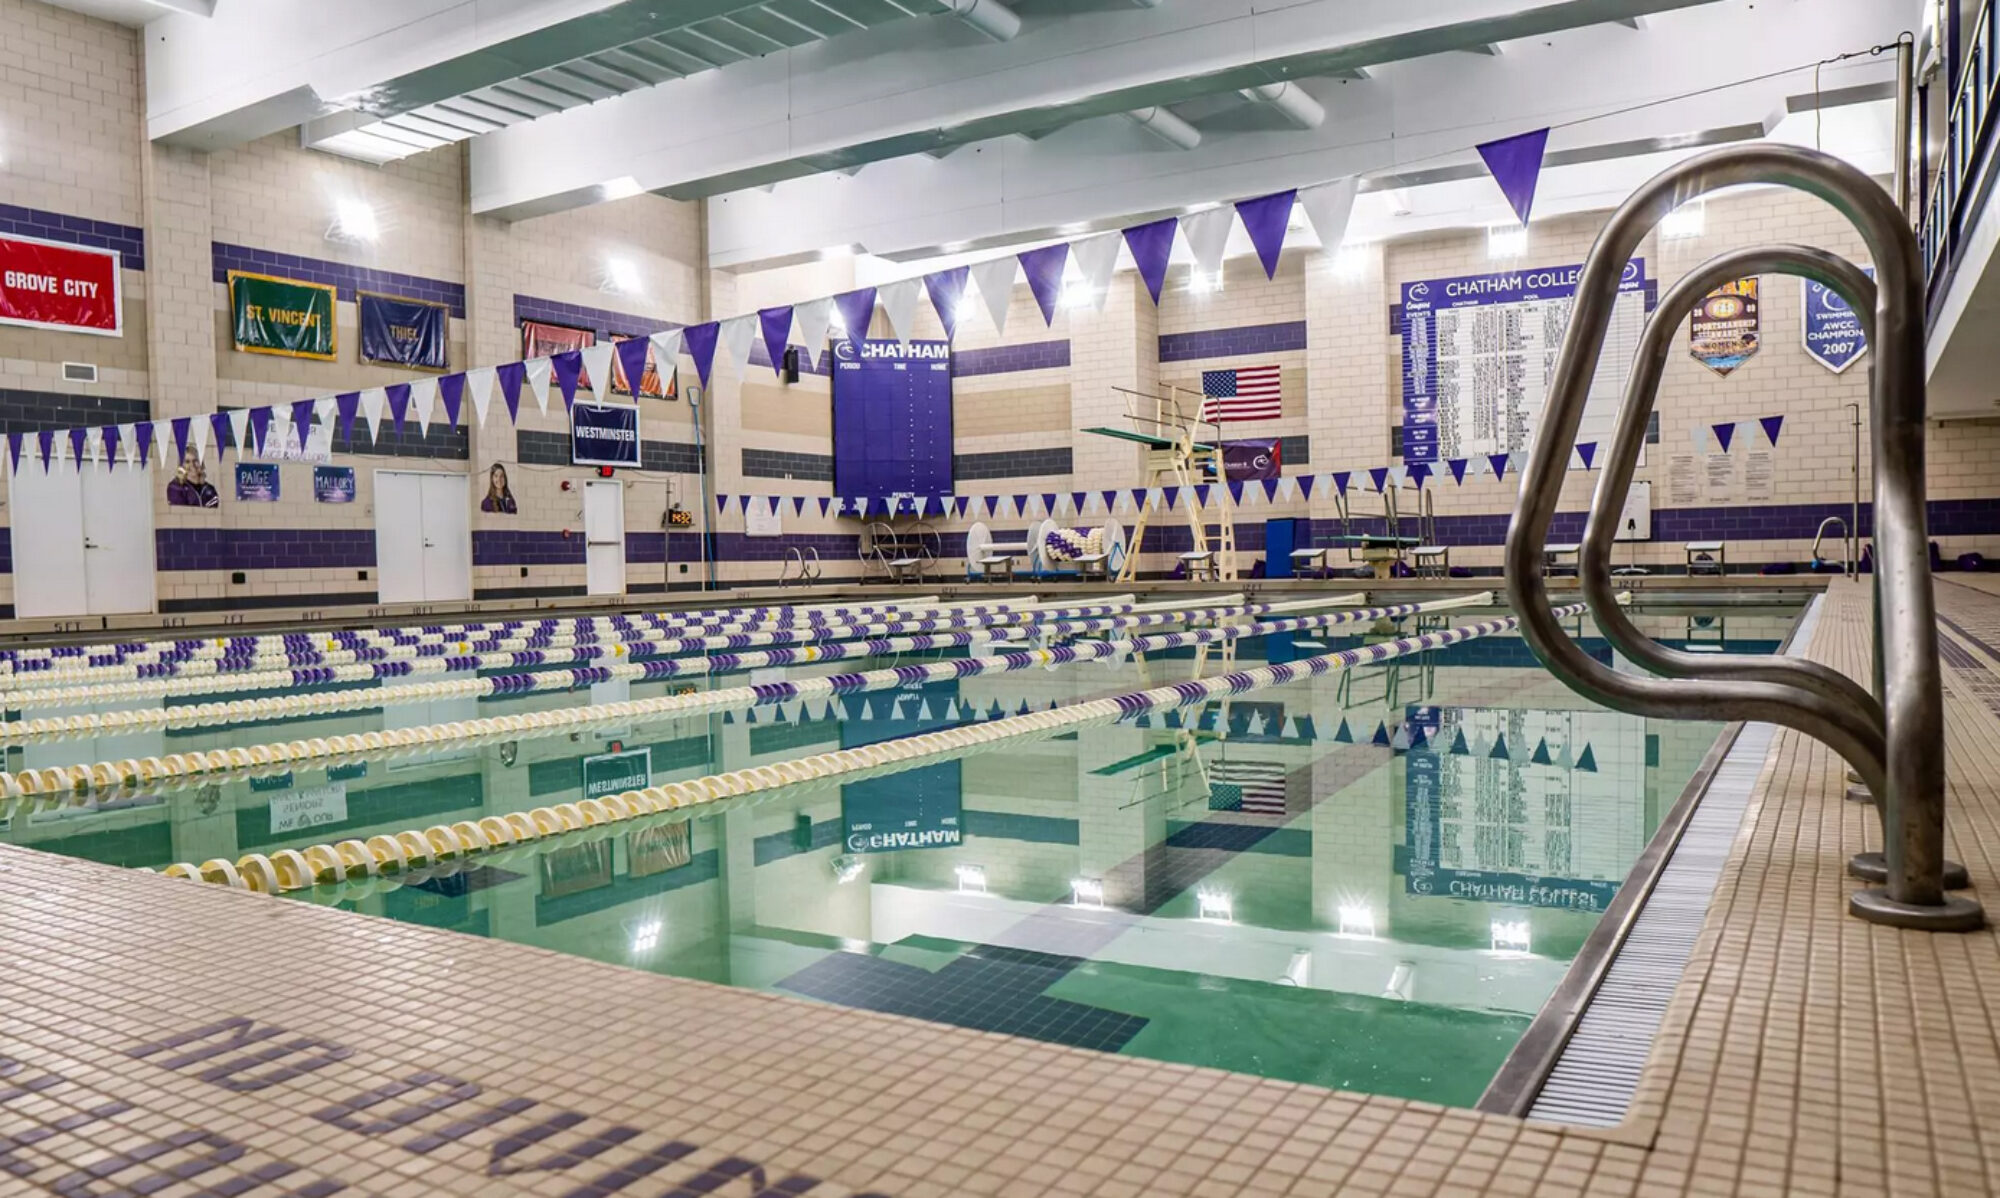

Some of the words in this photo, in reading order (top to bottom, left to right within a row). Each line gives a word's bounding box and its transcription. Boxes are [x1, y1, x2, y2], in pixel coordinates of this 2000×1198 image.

[5, 270, 58, 293] GROVE
[64, 279, 98, 299] CITY
[1446, 275, 1522, 296] CHATHAM
[246, 304, 265, 321] ST.
[268, 307, 322, 328] VINCENT
[1816, 310, 1856, 320] SWIMMIN
[1693, 319, 1757, 331] SPORTSMANSHIP
[1823, 321, 1855, 330] AWCC
[1808, 329, 1864, 340] CHAMPION
[861, 343, 949, 359] CHATHAM
[1823, 342, 1855, 355] 2007
[575, 426, 635, 442] WESTMINSTER
[241, 469, 270, 485] PAIGE
[315, 476, 354, 490] MALLORY
[126, 1016, 356, 1092] NO
[310, 1071, 890, 1198] DIVIN
